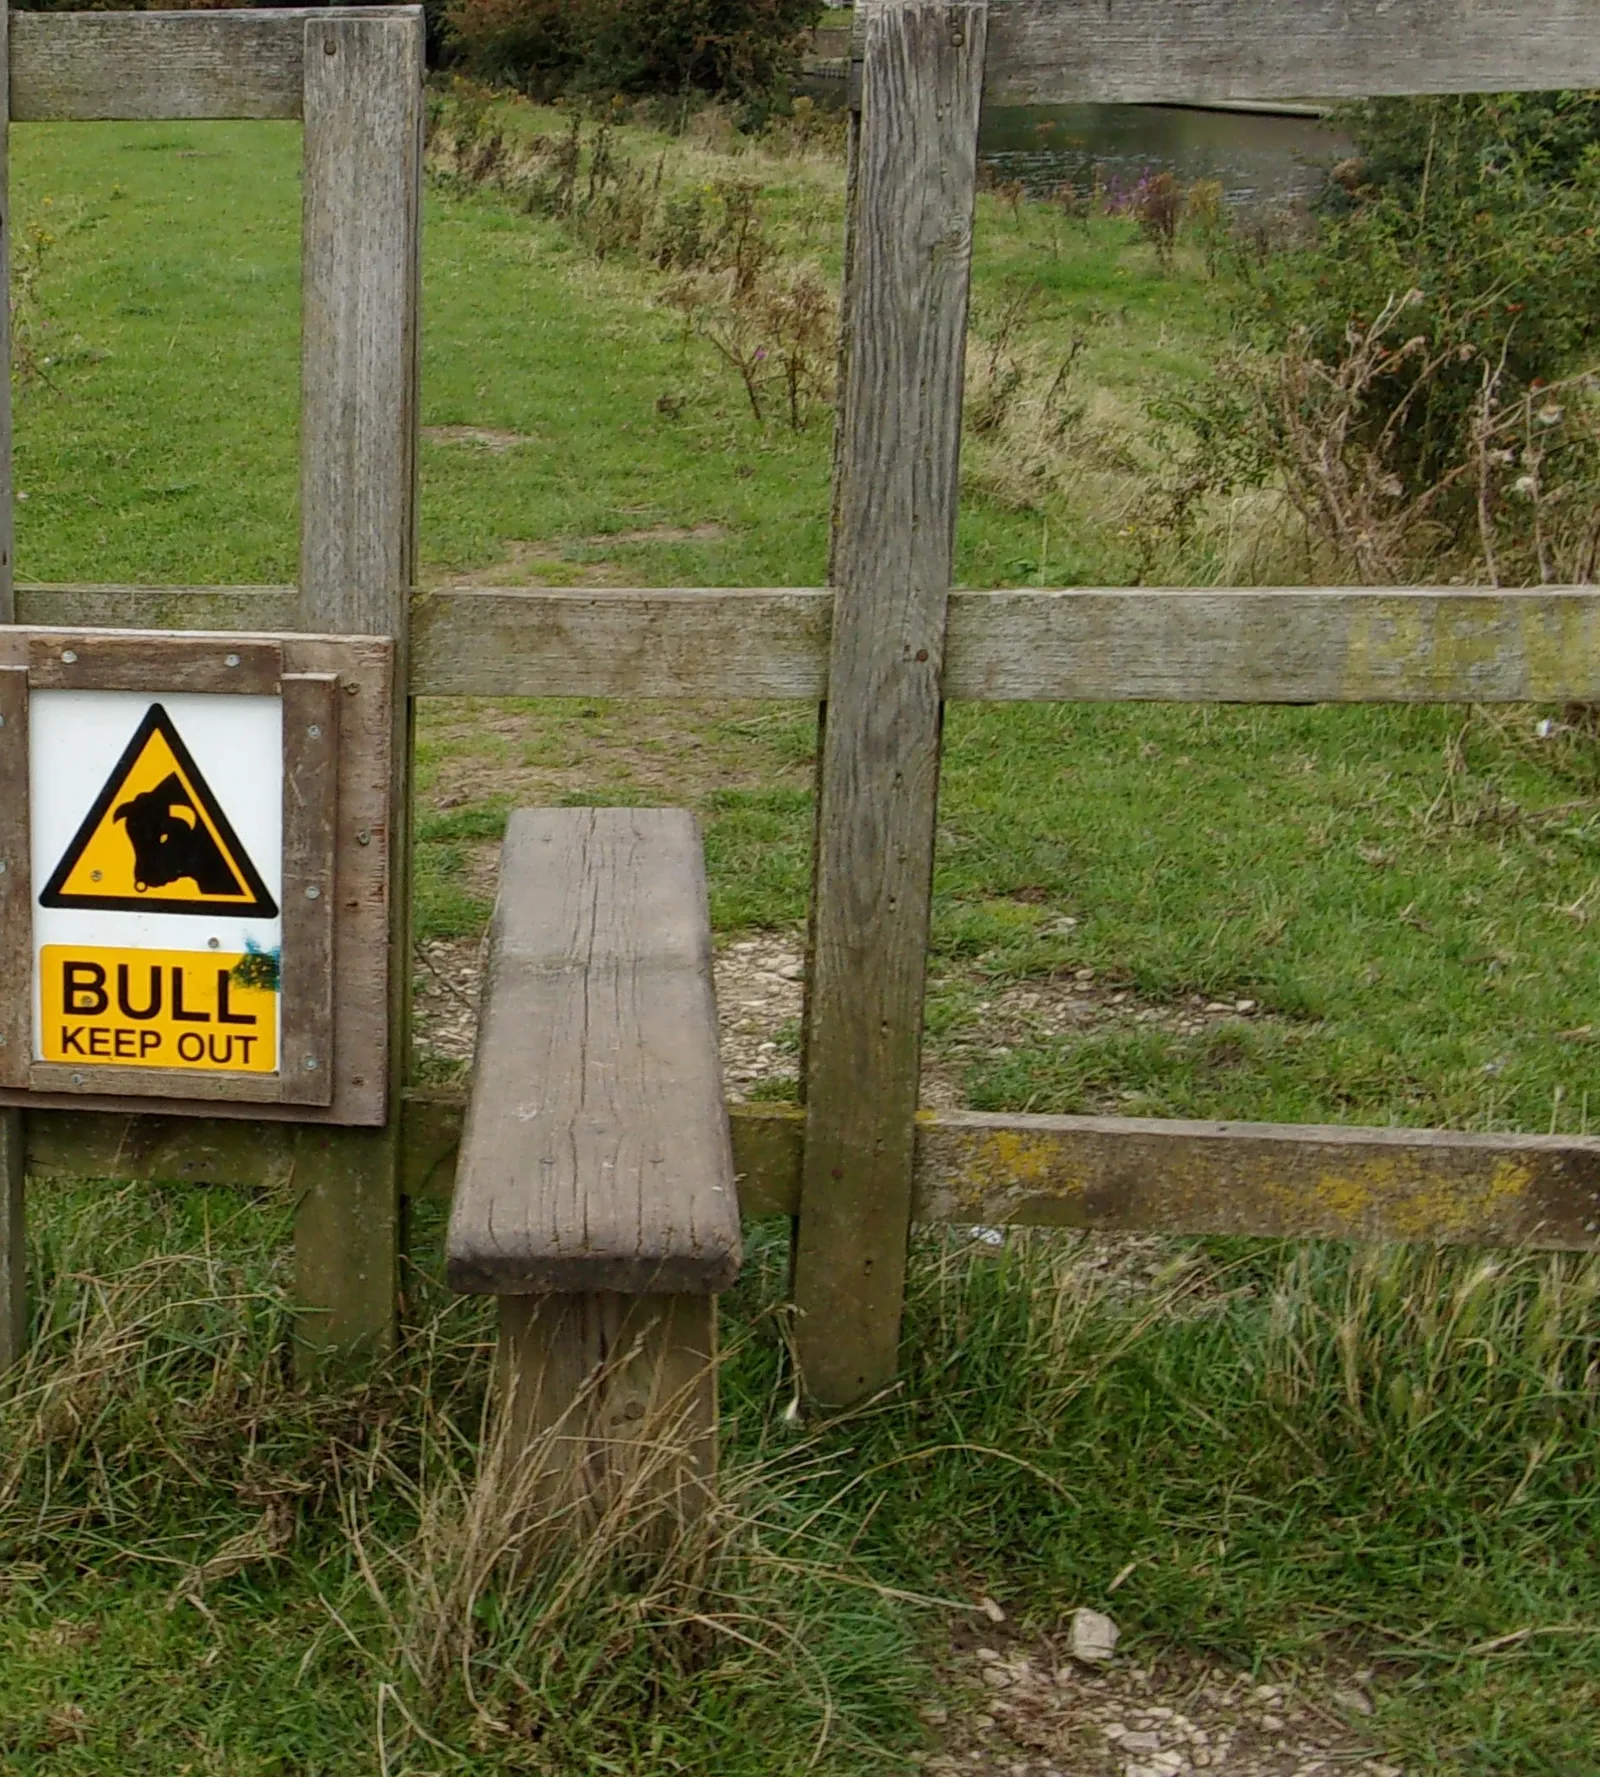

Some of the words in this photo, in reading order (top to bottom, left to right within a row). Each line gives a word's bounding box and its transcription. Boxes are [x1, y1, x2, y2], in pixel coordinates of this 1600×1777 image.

[62, 960, 257, 1025] BULL
[60, 1025, 163, 1059] KEEP
[177, 1031, 258, 1064] OUT
